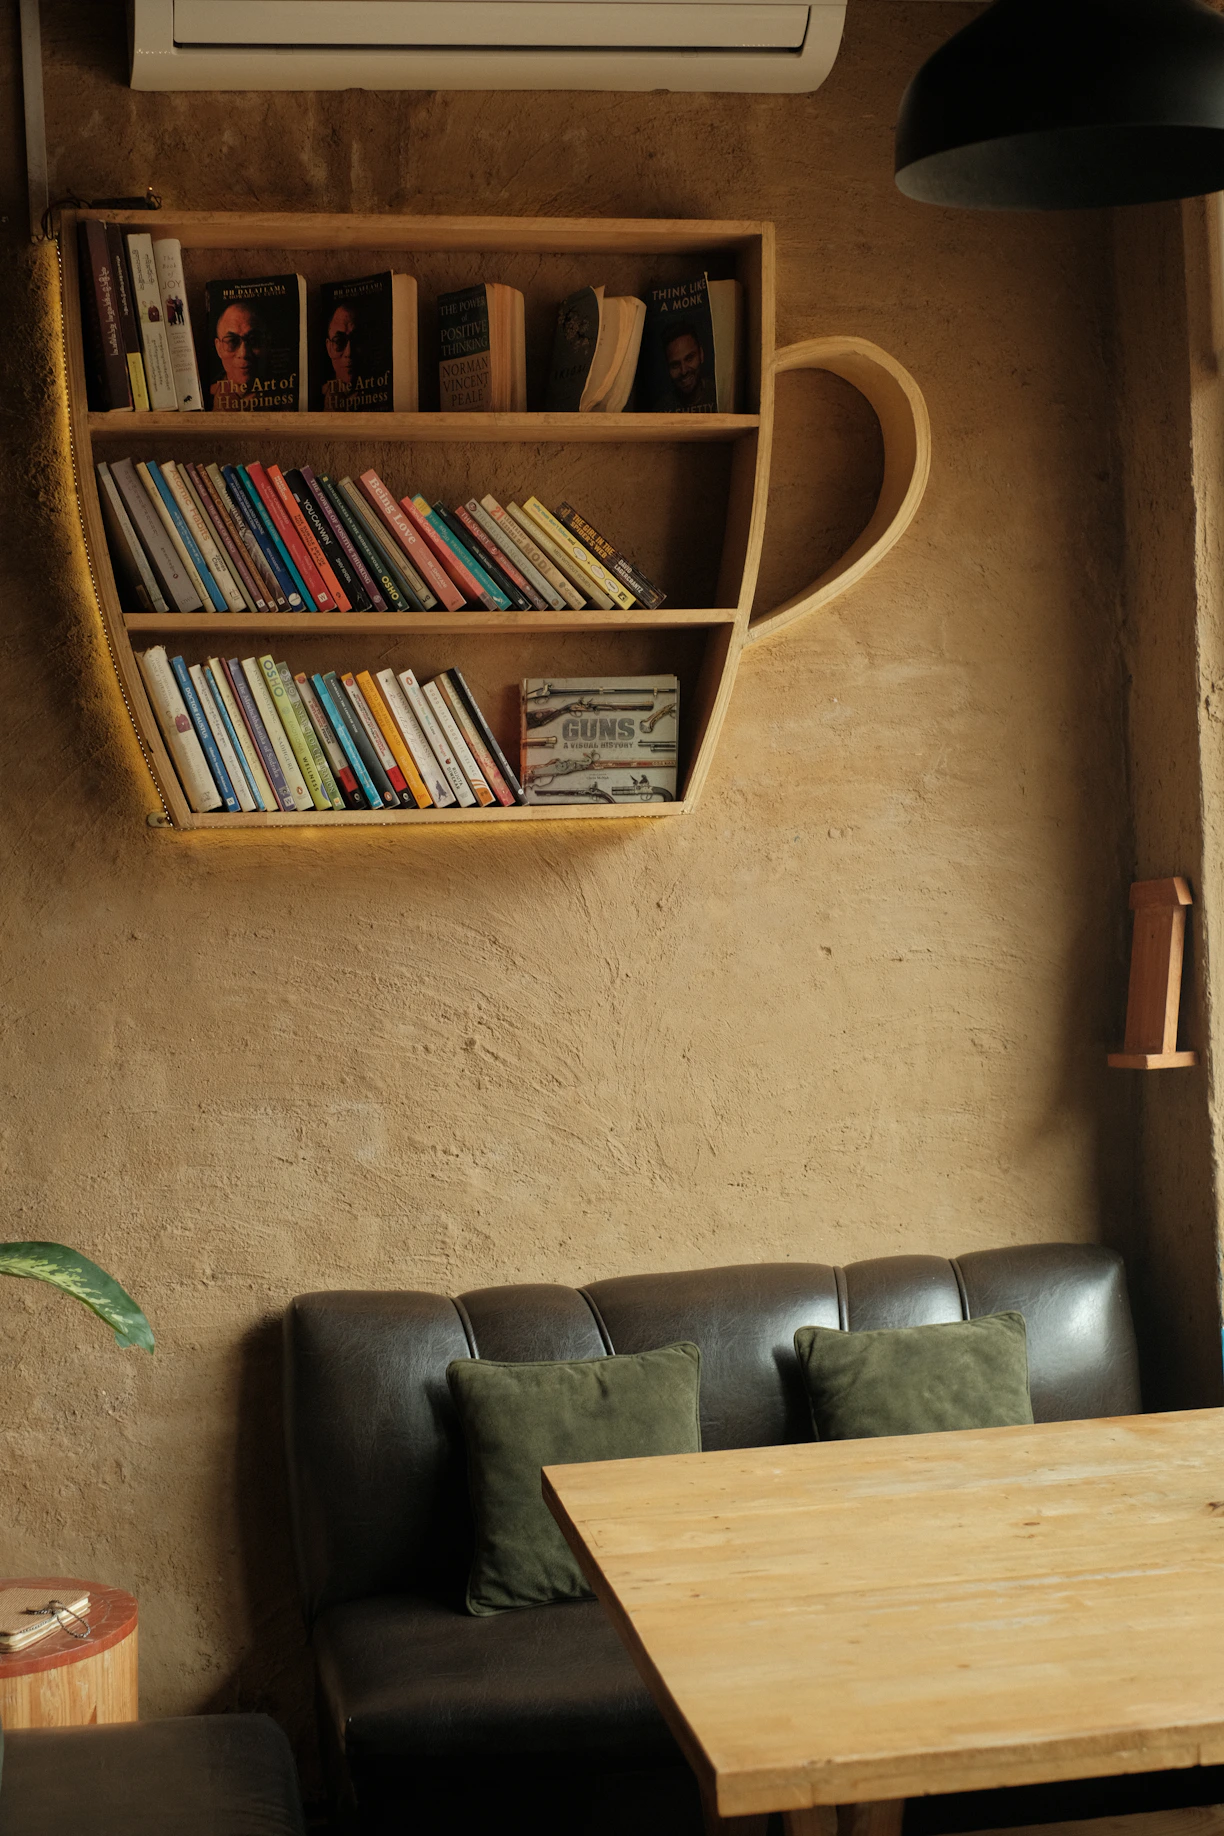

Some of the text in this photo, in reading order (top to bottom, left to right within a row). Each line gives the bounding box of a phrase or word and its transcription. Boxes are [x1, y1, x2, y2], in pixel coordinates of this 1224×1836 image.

[163, 280, 181, 289] JOY
[238, 287, 262, 295] DALAI
[264, 284, 286, 292] LAMA
[652, 278, 706, 300] THINK LIKE
[440, 296, 485, 316] THE POWER
[660, 294, 702, 312] A MONK
[441, 320, 487, 342] POSITIVE
[462, 314, 468, 322] of
[441, 336, 488, 356] THINKING
[442, 356, 488, 378] NORMAN
[216, 373, 296, 394] The Art of
[328, 370, 390, 394] The Art of
[443, 372, 488, 392] VINCENT
[217, 392, 294, 412] Happiness
[328, 392, 388, 411] Happiness
[452, 389, 483, 406] PEALE
[273, 476, 288, 500] MANSON
[276, 475, 286, 491] MARK
[169, 467, 193, 506] Atomic
[188, 507, 210, 541] Habits
[213, 474, 247, 532] THE MAHABHARATA
[238, 489, 250, 507] SPENSER
[247, 506, 256, 518] AND
[253, 517, 265, 535] DONNE
[240, 501, 257, 529] INTRODUCTION
[266, 485, 289, 524] LOVE CANONIZED
[302, 498, 316, 515] YOU
[366, 476, 397, 514] Being
[391, 512, 418, 545] Love
[490, 505, 505, 520] 21
[293, 515, 301, 527] NOT
[299, 527, 311, 546] GIVING
[308, 478, 371, 584] THE POWER OF POSITIVE THINKING
[326, 483, 349, 517] MINDFULNESS
[350, 523, 359, 534] THE
[357, 534, 372, 555] MODERN
[369, 555, 382, 573] WORLD
[408, 505, 425, 523] Paulo
[421, 521, 441, 542] Coelho
[460, 511, 490, 545] THE SECRET
[499, 519, 516, 538] LESSONS
[503, 515, 526, 540] LEADERSHIP
[513, 508, 530, 525] HARUKI
[528, 524, 552, 548] MURAKAMI
[532, 502, 575, 545] why men don't listen and
[571, 513, 615, 555] THE GIRL IN THE
[296, 513, 325, 565] THE SUBTLE ART OF
[428, 514, 438, 525] THE
[449, 539, 473, 566] PRINCIPLE
[474, 509, 529, 571] THE GREATEST SECRET
[569, 521, 595, 546] SPIDER'S
[593, 544, 608, 558] WEB
[211, 556, 222, 572] Clear
[214, 553, 227, 571] James
[335, 557, 352, 583] SHIV KHERA
[522, 542, 552, 574] MODI
[552, 548, 591, 588] MEN WITHOUT WOMEN
[617, 559, 632, 573] DAVID
[379, 574, 400, 601] OSHO
[426, 560, 434, 569] BK
[431, 567, 448, 588] SHIVANI
[613, 563, 643, 593] LAGERCRANTZ
[262, 658, 285, 698] OSHO
[279, 668, 296, 697] OSHO
[443, 678, 462, 707] OSHO
[252, 669, 276, 724] INNER ENGINEERING
[360, 681, 385, 727] INFLUENCE PEOPLE
[184, 686, 208, 738] DOCTOR FAUSTUS
[309, 703, 331, 744] INFLUENCE PEOPLE
[311, 696, 319, 708] HOW
[323, 724, 335, 744] FRIENDS
[364, 679, 400, 745] HOW TO WIN FRIENDS AND
[396, 691, 431, 758] DANNY SCHEINMANN
[429, 688, 464, 753] GOOD GOOD LIFE
[459, 708, 479, 743] THE BOOK OF
[237, 681, 280, 778] The Mrichchhakatika of Sudraka
[562, 718, 635, 742] GUNS
[276, 735, 293, 772] SADHGURU
[287, 720, 319, 792] EMOTIONAL WELLNESS
[293, 699, 335, 793] IN SEARCH OF CELEBRATION
[437, 743, 447, 757] Weight
[446, 766, 460, 789] DIWEKAR
[451, 766, 463, 786] RUJUTA
[468, 764, 476, 776] KING
